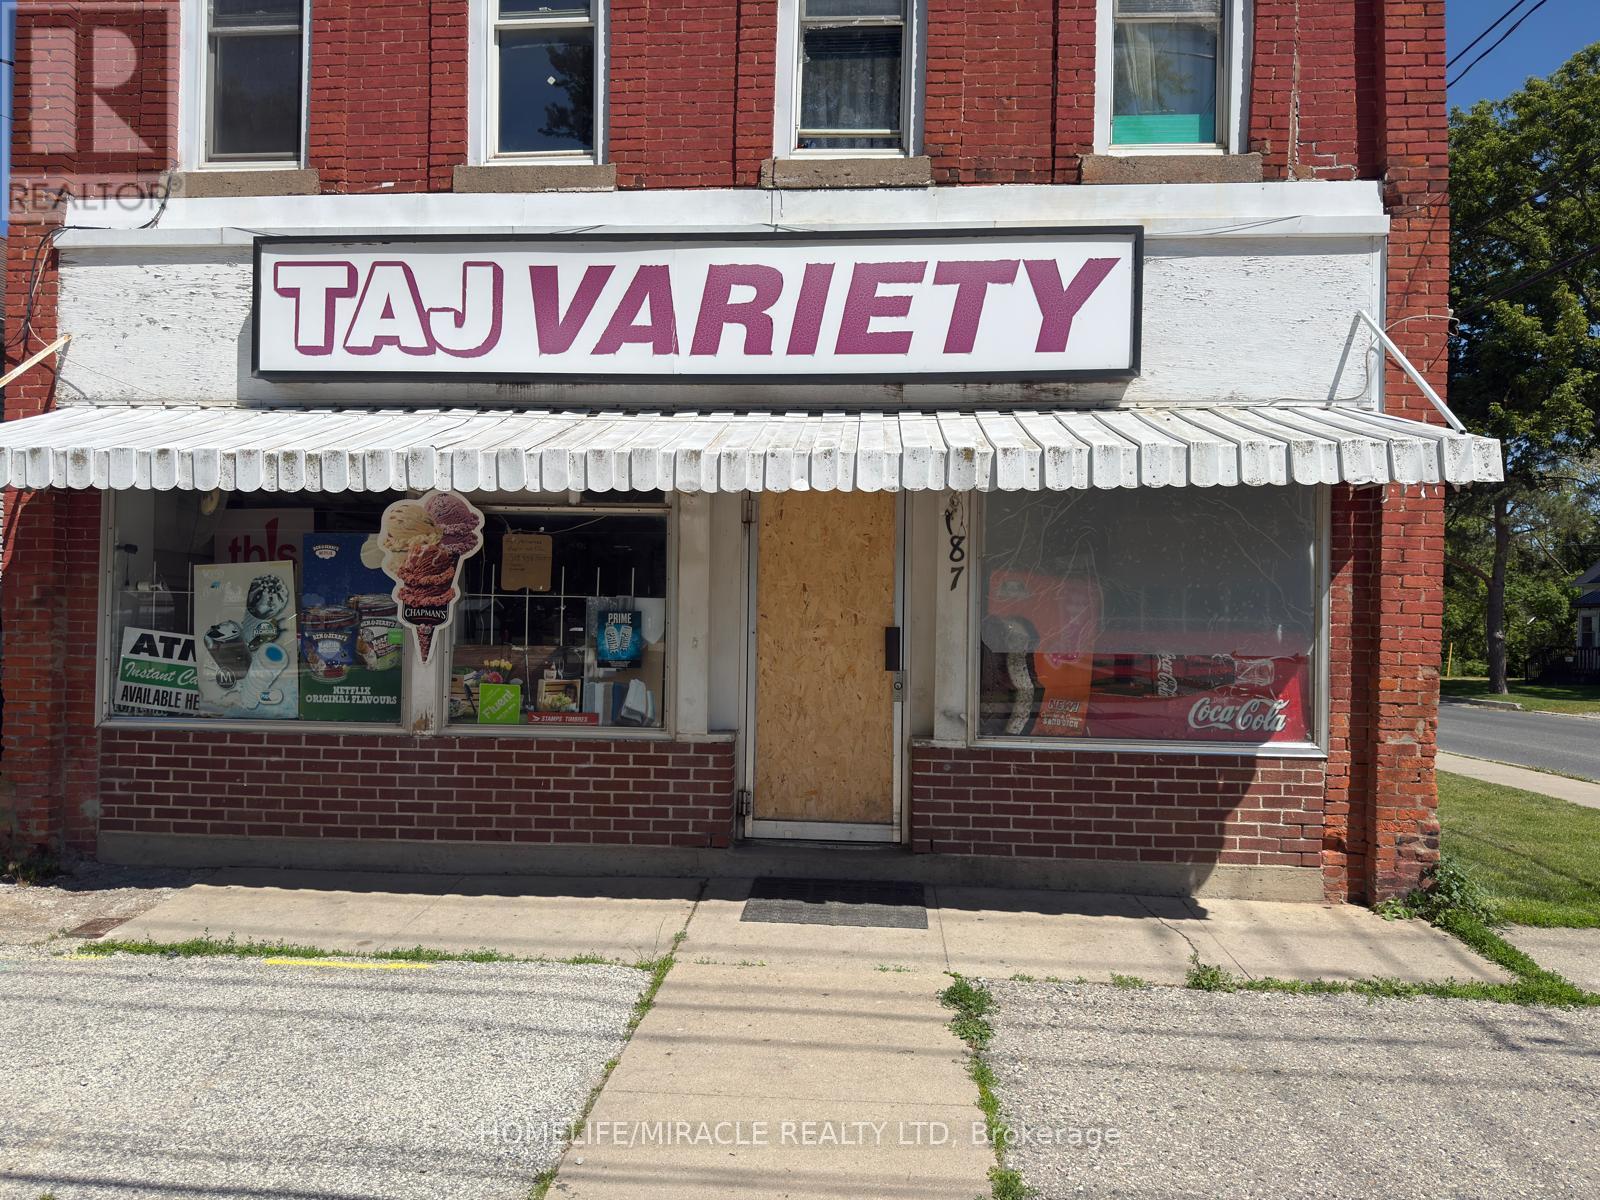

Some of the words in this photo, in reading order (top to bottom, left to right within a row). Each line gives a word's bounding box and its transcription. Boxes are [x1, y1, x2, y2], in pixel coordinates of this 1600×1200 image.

[274, 261, 504, 358] TAJ
[528, 257, 1121, 356] VARIETY
[404, 608, 446, 620] CHAPMAN'S
[608, 612, 632, 624] PRIME
[125, 661, 176, 682] Instant
[121, 685, 182, 709] AVAILABLE
[333, 686, 371, 695] NETFLIX
[305, 694, 350, 704] ORIGINAL
[351, 695, 397, 705] FLAVOURS
[482, 689, 515, 719] Fluent
